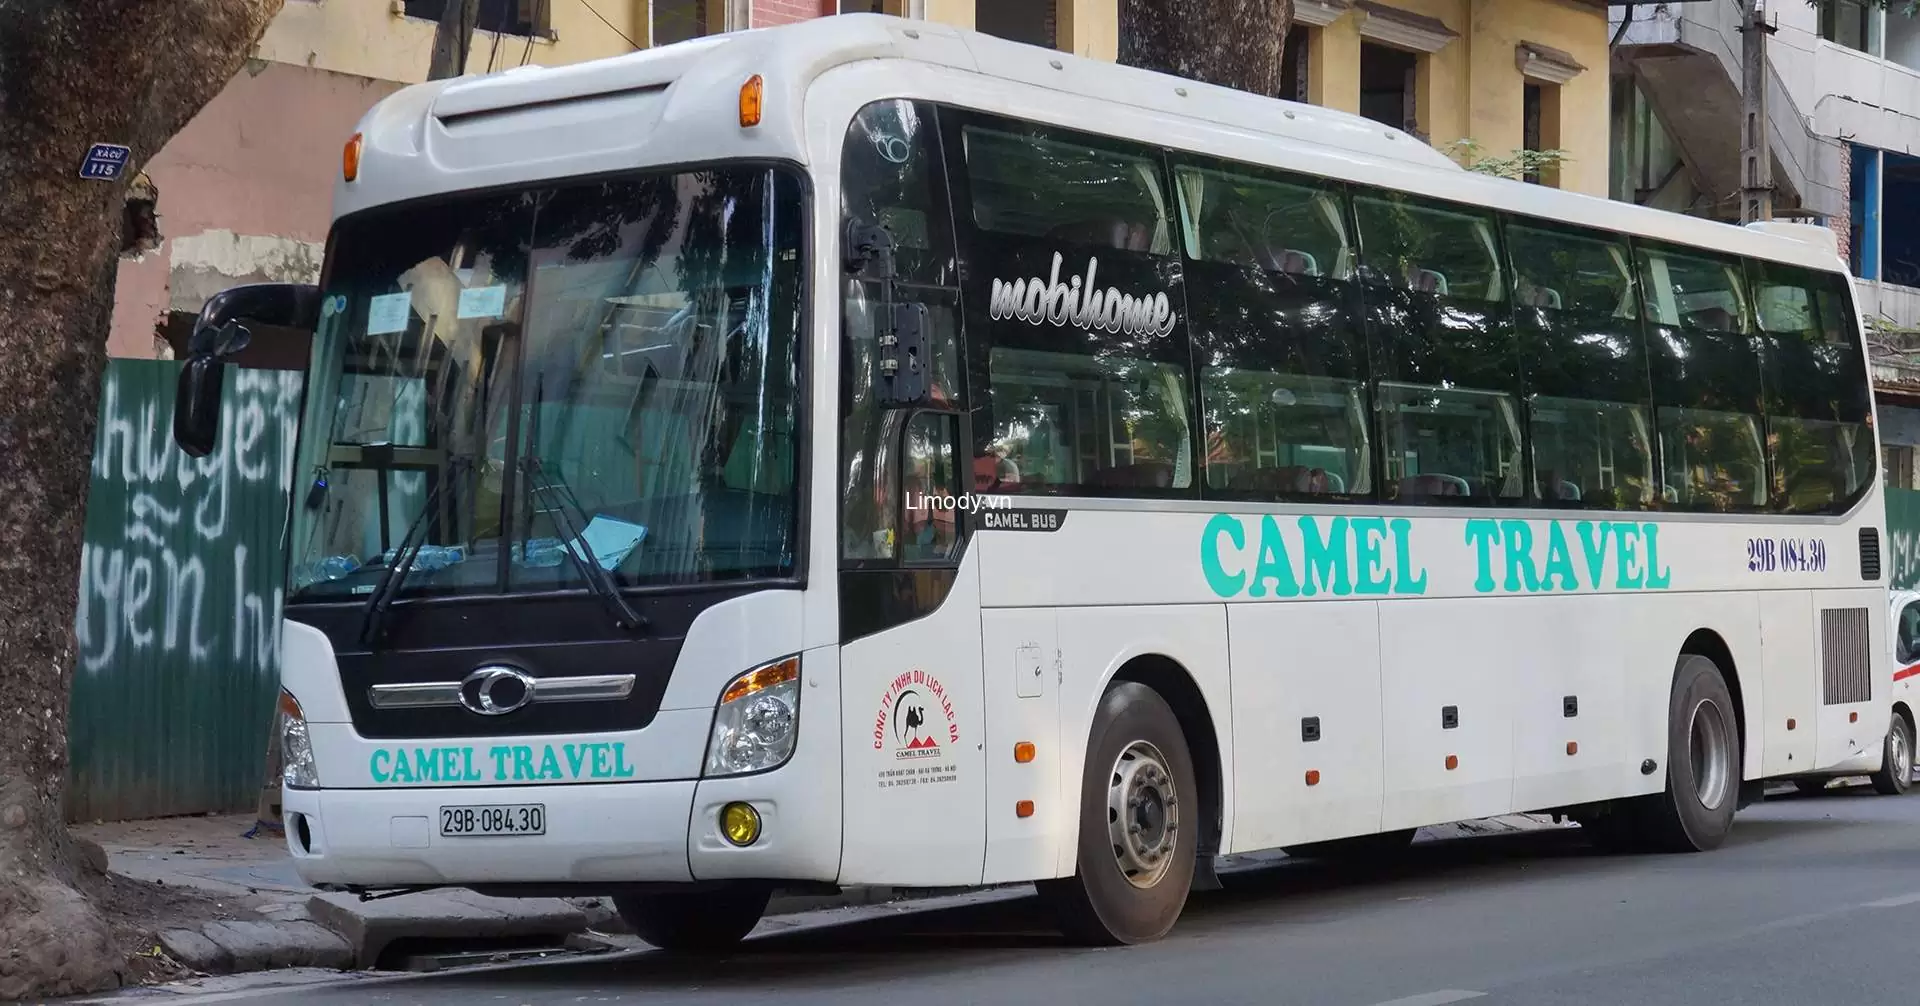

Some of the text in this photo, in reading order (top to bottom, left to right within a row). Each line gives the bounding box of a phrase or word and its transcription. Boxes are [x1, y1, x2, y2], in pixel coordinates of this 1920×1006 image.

[91, 163, 116, 175] 115
[990, 251, 1176, 337] mobihome
[985, 512, 1057, 528] CAMEL BUS
[1200, 513, 1670, 598] CAMEL TRAVEL
[1747, 538, 1826, 572] 29B 084.30
[882, 691, 893, 709] TY
[891, 671, 912, 695] TNHH
[914, 670, 925, 684] DU
[370, 741, 634, 783] CAMEL TRAVEL
[896, 748, 941, 758] CAMEL TRAVEL
[442, 807, 542, 833] 29B-084.30
